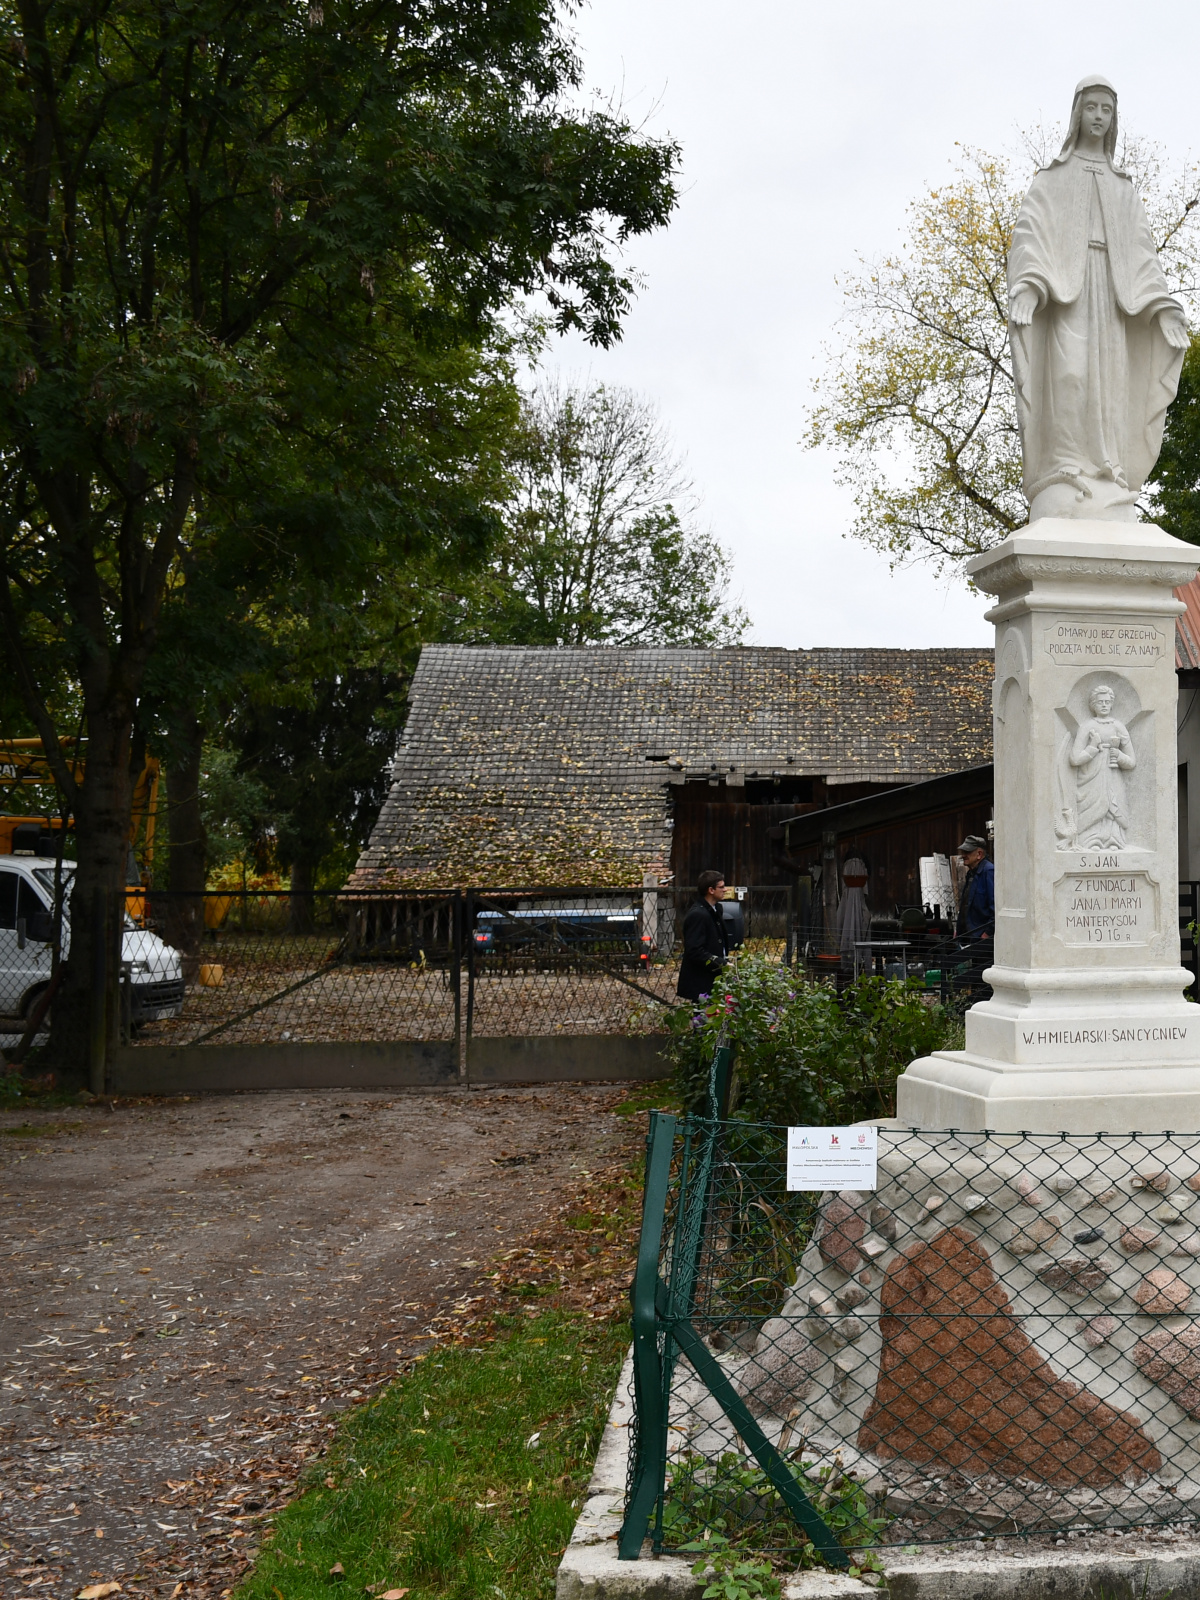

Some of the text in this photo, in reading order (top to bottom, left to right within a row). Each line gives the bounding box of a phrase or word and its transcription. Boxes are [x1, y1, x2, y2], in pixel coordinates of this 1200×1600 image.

[1101, 629, 1116, 639] BEZ
[1118, 628, 1157, 640] GRZECHU
[1049, 643, 1083, 656] POCZĘTA
[1108, 644, 1121, 656] SIĘ
[1124, 645, 1138, 655] ZA
[1139, 645, 1161, 656] NAMI
[0, 764, 19, 779] AT
[1079, 856, 1092, 868] S.
[1074, 879, 1136, 893] Z FUNDACJI
[1071, 898, 1101, 911] JANA
[1111, 897, 1142, 910] MARYI
[1066, 911, 1137, 928] MANTERYSÓW
[1087, 928, 1121, 942] 1916
[1022, 1032, 1035, 1045] W.
